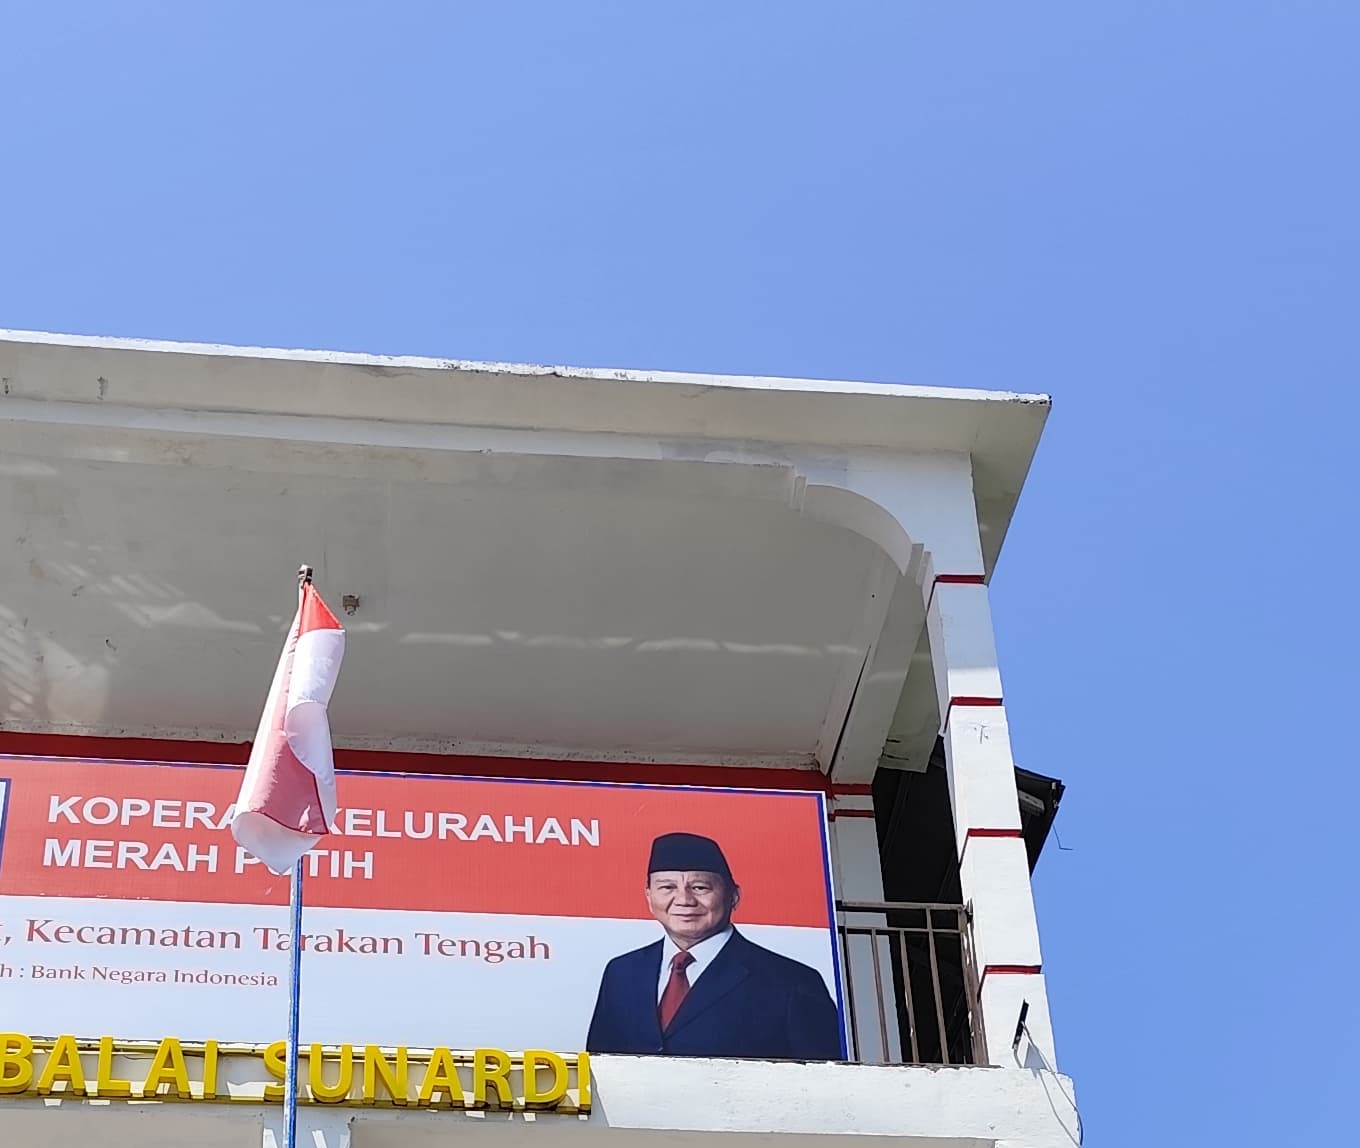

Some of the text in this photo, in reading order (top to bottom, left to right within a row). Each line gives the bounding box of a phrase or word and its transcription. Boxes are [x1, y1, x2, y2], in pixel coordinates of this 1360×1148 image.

[48, 795, 238, 830] KOPER
[43, 838, 373, 880] MERAH PTIH
[26, 918, 242, 949] Kecamatan
[253, 927, 404, 955] Tarakan
[414, 932, 551, 964] Tengah
[31, 964, 86, 980] Bank
[92, 966, 167, 984] Negara
[174, 969, 278, 987] Indonesia
[264, 1040, 591, 1112] SUNARDI
